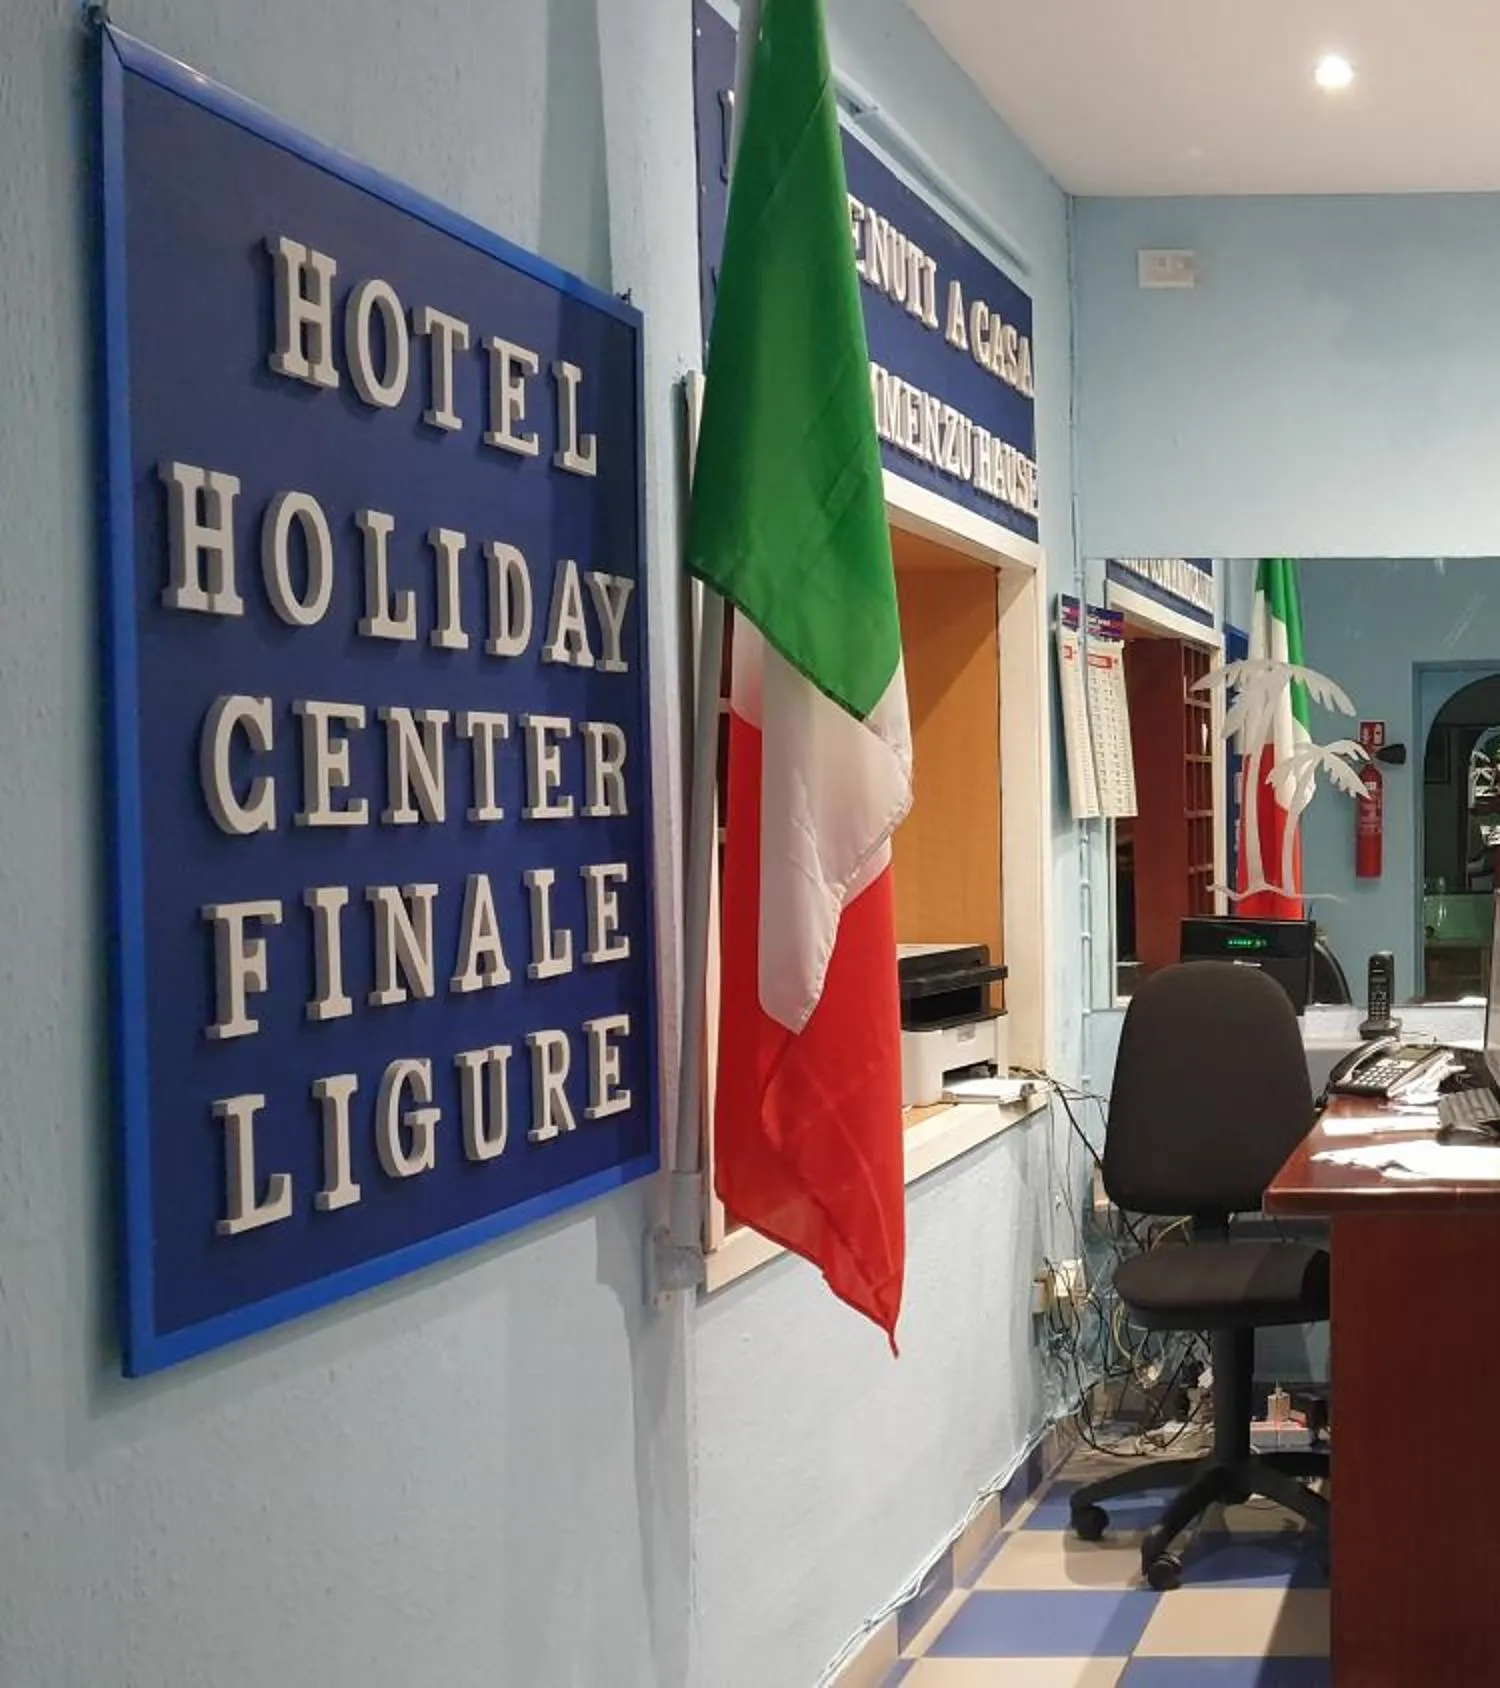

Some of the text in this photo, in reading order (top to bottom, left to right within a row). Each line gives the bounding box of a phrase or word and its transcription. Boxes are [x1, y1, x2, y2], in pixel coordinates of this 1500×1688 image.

[267, 235, 598, 478] HOTEL
[847, 192, 1036, 399] ENUTI A CASA
[159, 461, 636, 673] HOLIDAY
[200, 694, 629, 835] CENTER
[201, 863, 631, 1040] FINALE
[212, 1015, 632, 1236] LIGURE
